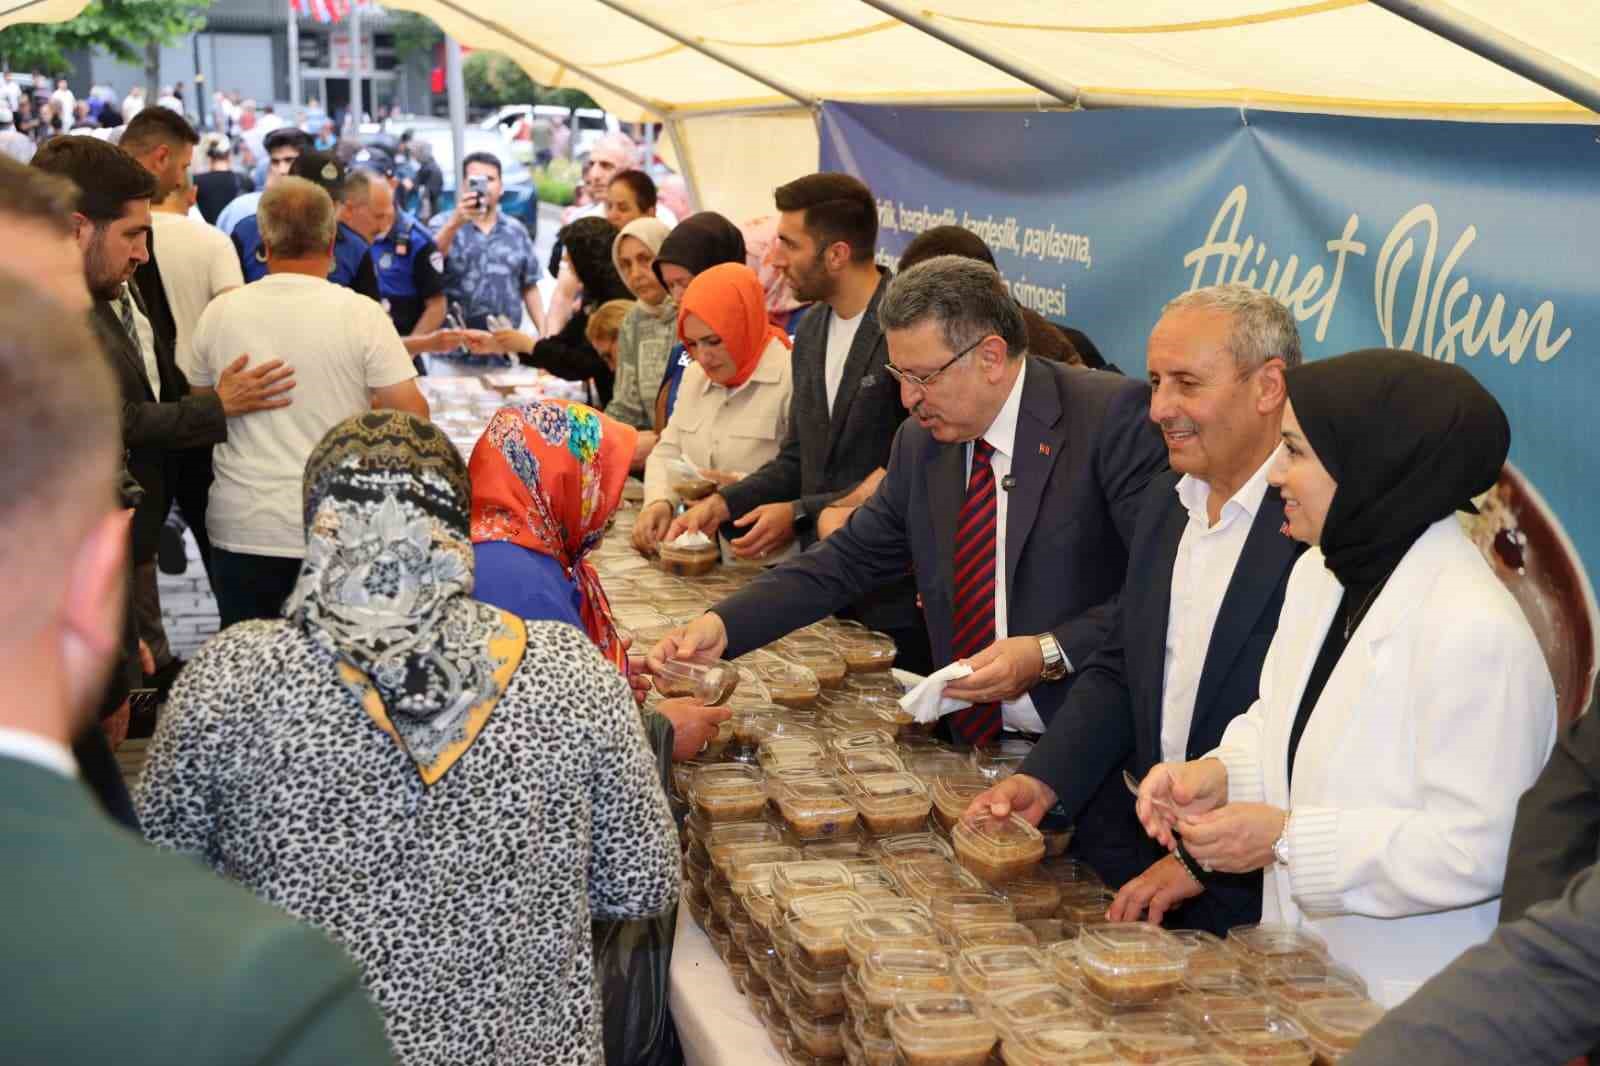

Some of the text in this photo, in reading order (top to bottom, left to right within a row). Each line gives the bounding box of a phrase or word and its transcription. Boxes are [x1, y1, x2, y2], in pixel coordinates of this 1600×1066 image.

[1022, 223, 1092, 269] paylaşma,
[1012, 274, 1067, 317] simgesi
[1374, 203, 1572, 365] Olsun
